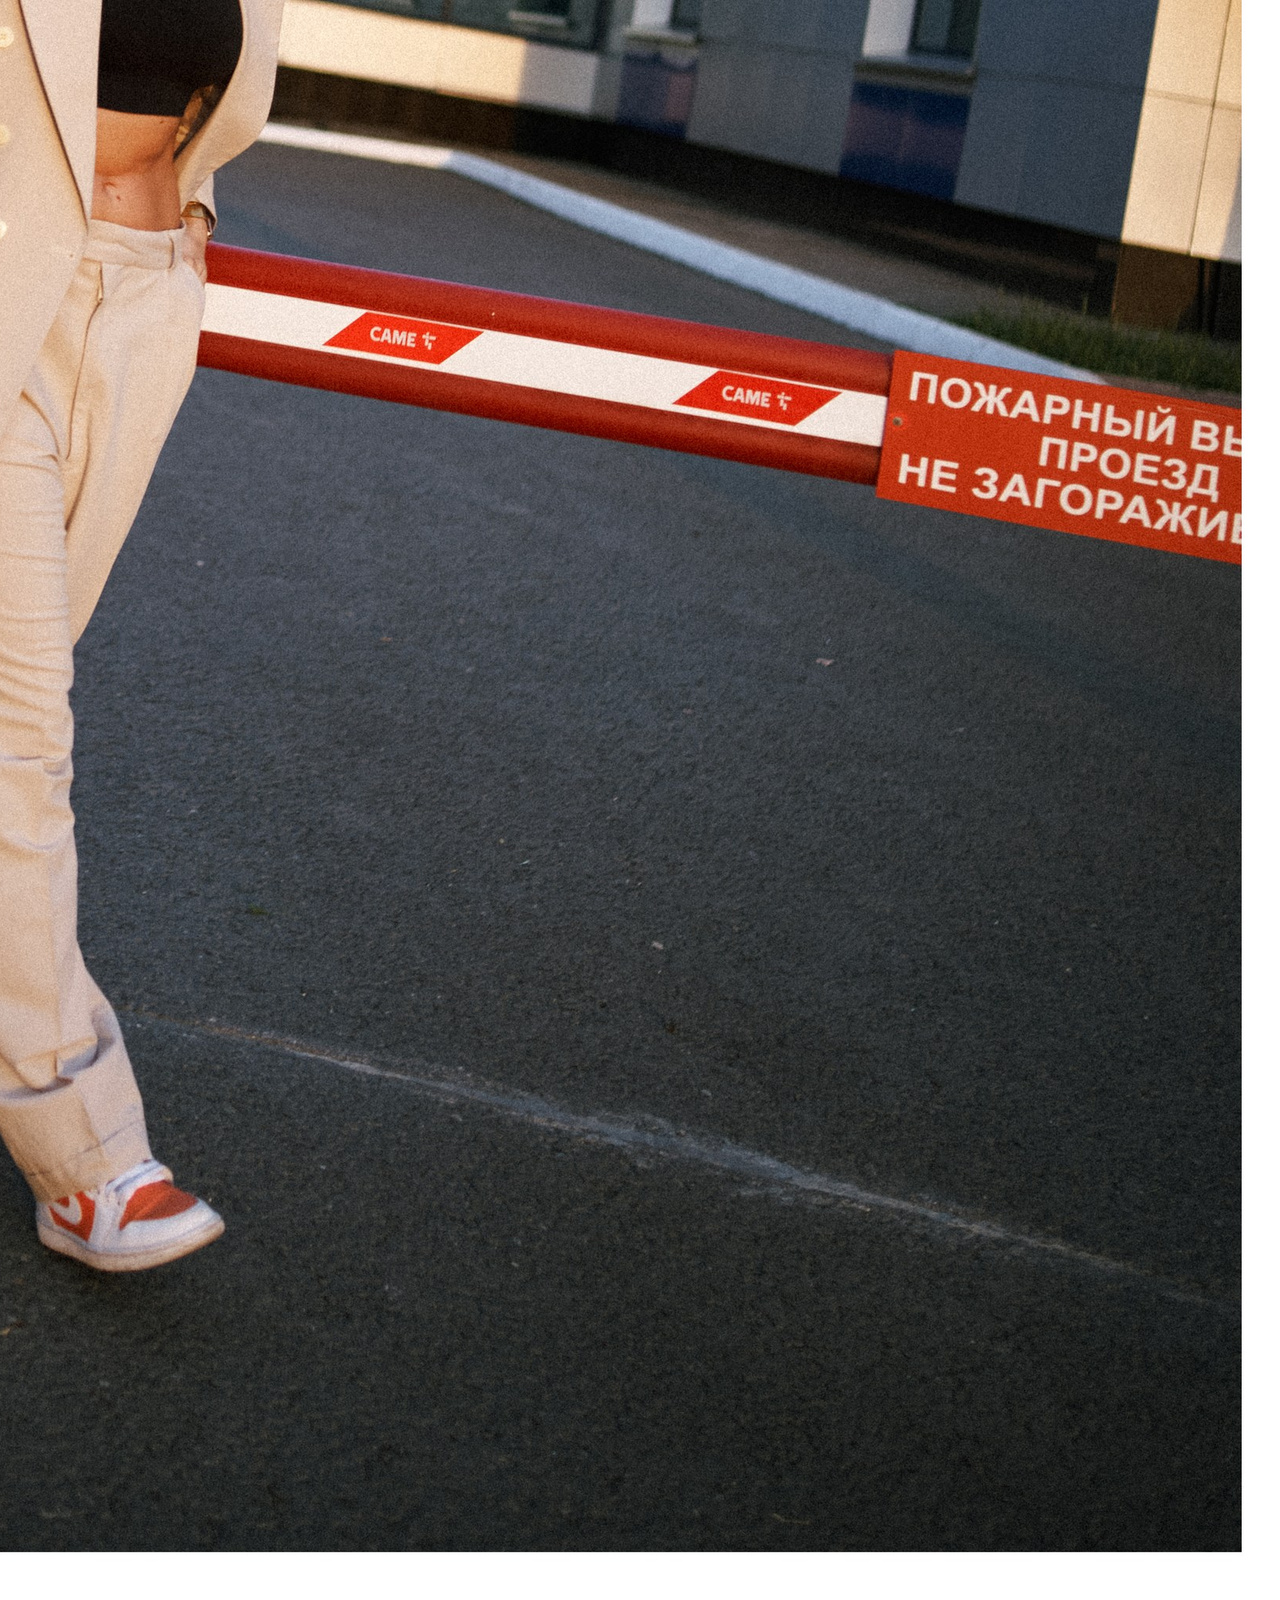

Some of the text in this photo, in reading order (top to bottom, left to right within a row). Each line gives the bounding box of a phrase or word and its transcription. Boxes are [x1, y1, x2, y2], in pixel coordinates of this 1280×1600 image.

[369, 326, 417, 347] CAME
[721, 385, 771, 408] CAME
[909, 370, 1177, 446] ПОЖАРНЫЙ
[898, 453, 960, 494] НЕ
[1038, 436, 1220, 503] ПРОЕЗД
